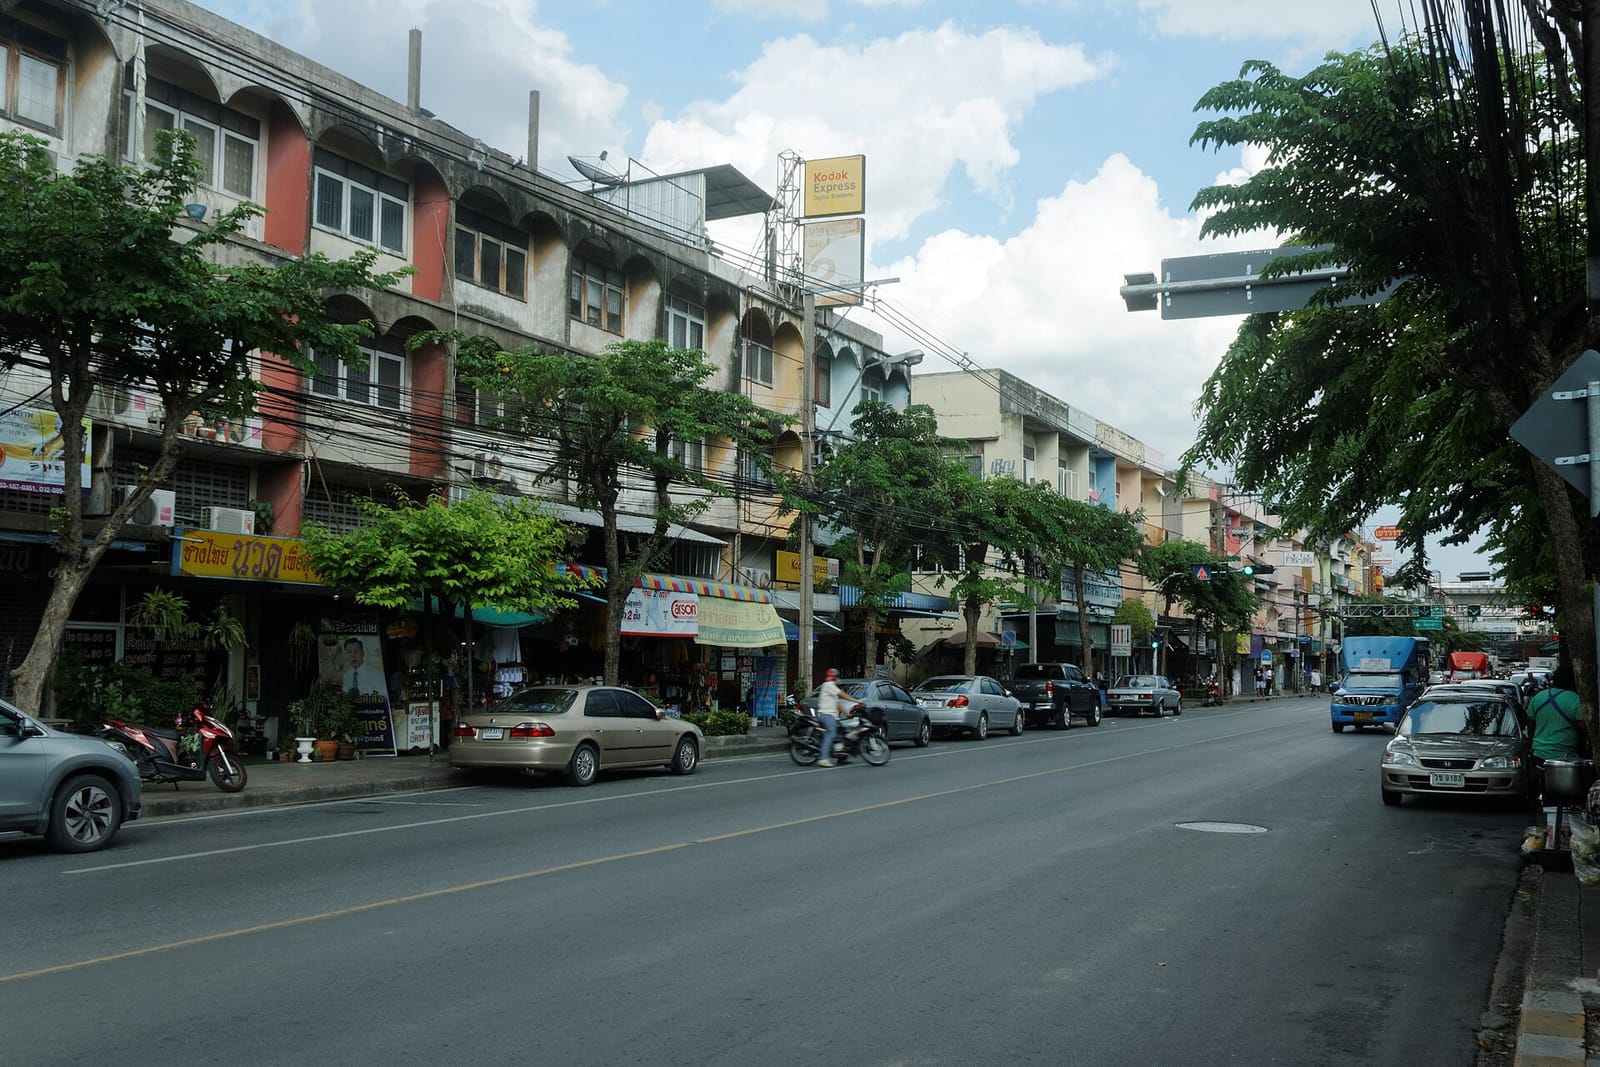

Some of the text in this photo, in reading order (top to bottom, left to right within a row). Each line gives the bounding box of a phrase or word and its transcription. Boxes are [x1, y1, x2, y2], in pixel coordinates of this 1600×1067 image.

[814, 170, 848, 182] Kodak
[814, 182, 856, 193] Express
[627, 610, 633, 620] 2
[670, 600, 697, 619] Carson
